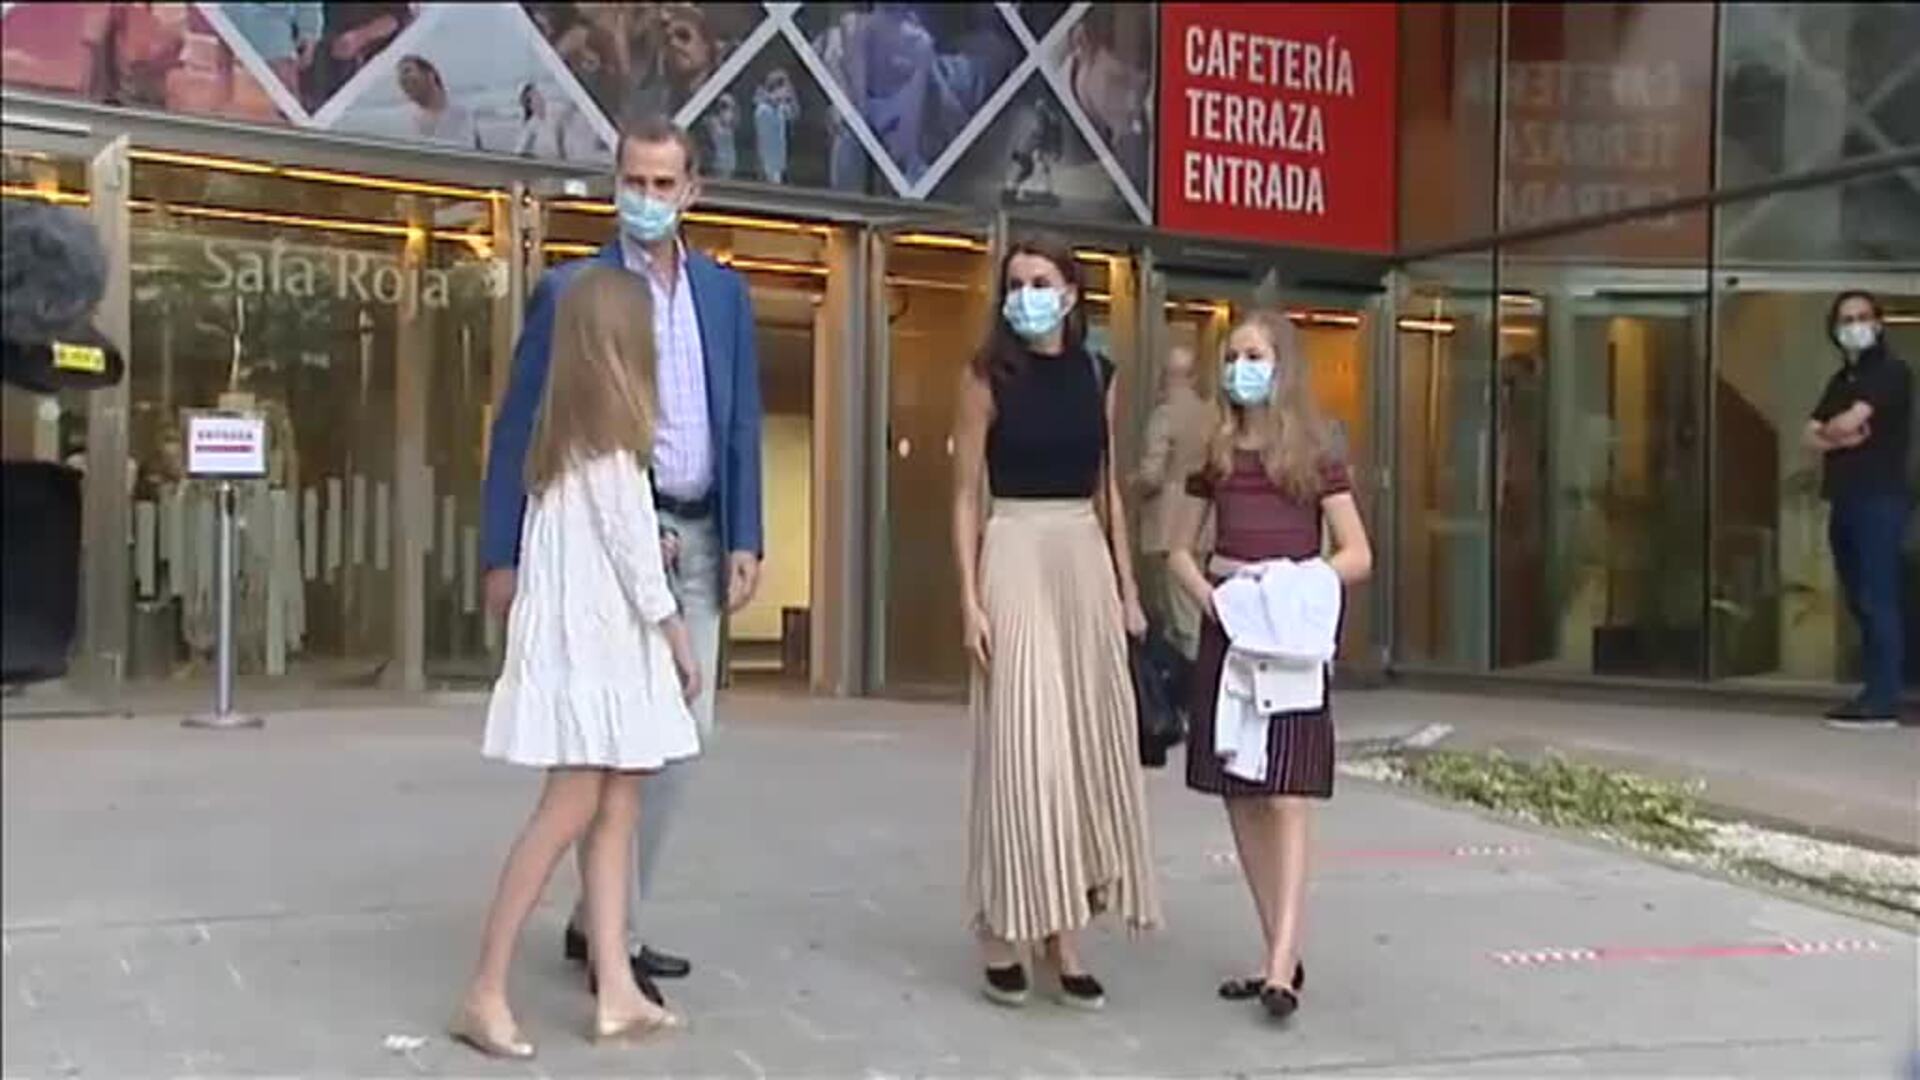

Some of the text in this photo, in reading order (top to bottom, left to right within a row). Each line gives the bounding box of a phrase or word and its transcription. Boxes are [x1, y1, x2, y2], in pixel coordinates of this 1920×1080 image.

[1186, 25, 1354, 96] CAFETERÍA
[1185, 87, 1325, 155] TERRAZA
[1184, 150, 1326, 216] ENTRADA
[202, 238, 450, 320] Sala Roja
